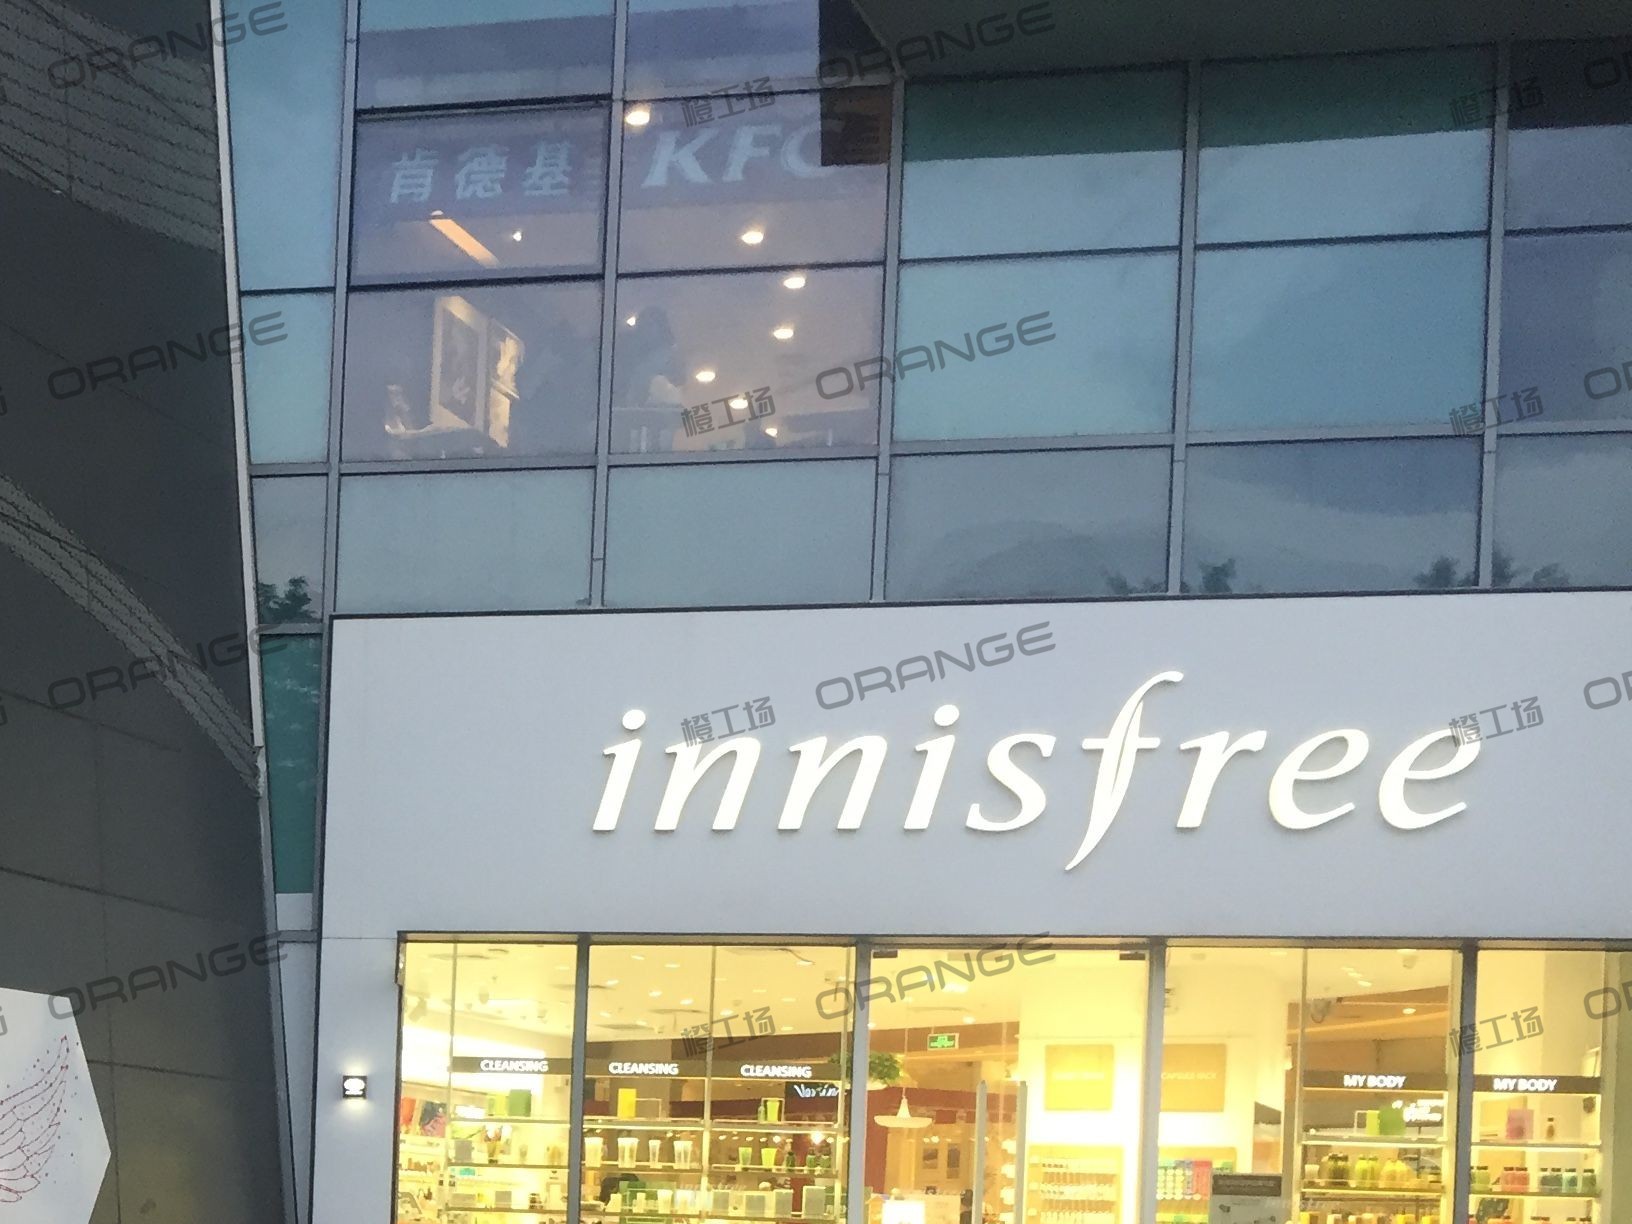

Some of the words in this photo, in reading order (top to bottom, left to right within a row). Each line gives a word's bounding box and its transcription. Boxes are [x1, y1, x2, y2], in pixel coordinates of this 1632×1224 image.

[389, 139, 573, 204] 肯德基
[592, 671, 1483, 872] innisfree
[479, 1059, 549, 1072] CLEANSING
[608, 1062, 679, 1076] CLEANSING
[740, 1064, 812, 1079] CLEANSING
[1343, 1074, 1366, 1087] MY
[1367, 1075, 1407, 1088] BODY
[1492, 1077, 1518, 1091] MY
[1518, 1078, 1558, 1092] BODY
